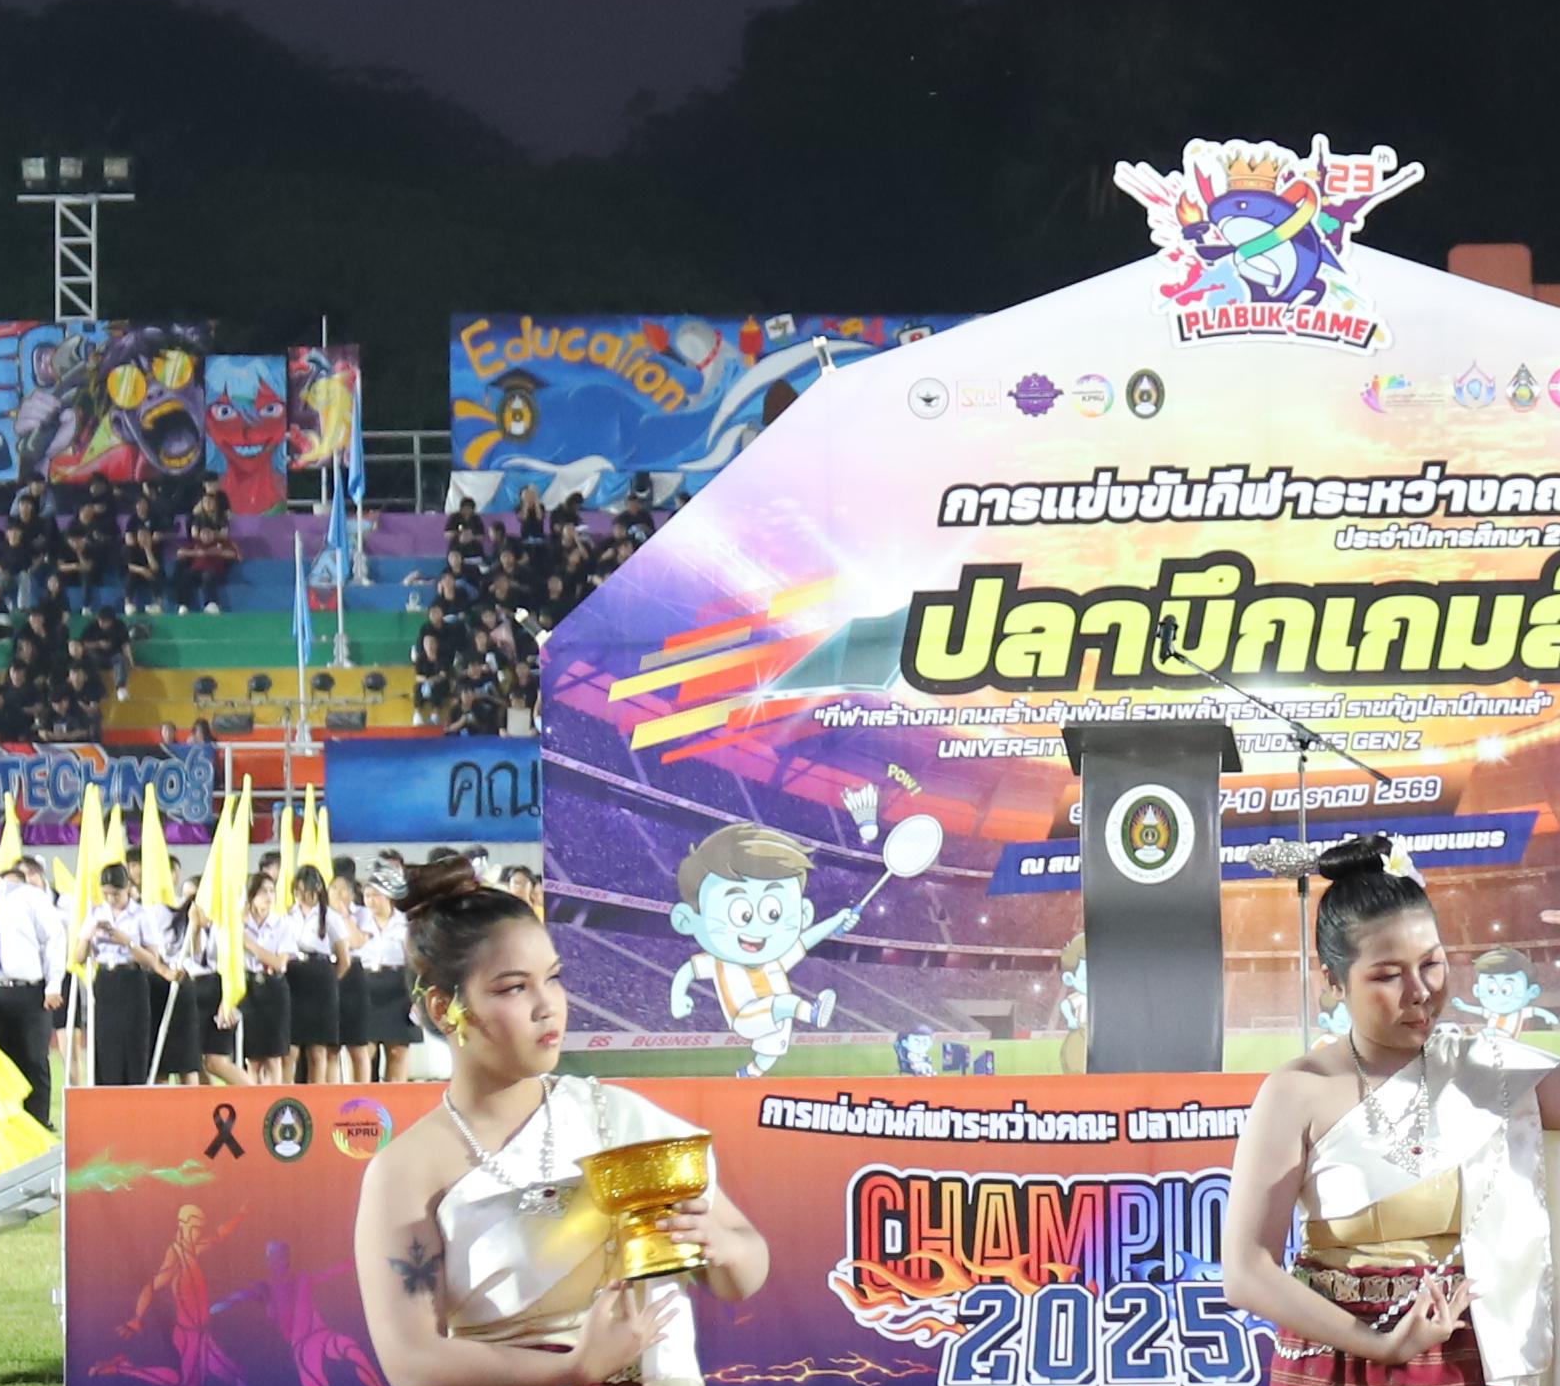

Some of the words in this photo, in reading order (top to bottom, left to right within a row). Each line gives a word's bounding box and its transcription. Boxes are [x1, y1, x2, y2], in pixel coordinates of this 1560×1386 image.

[460, 316, 690, 412] Education
[1351, 732, 1400, 751] GEN
[1400, 730, 1422, 750] Z
[1377, 774, 1443, 804] 2569
[347, 1127, 379, 1138] KPRU
[761, 1093, 1118, 1143] การแข่งขันกีฬาระหว่างคณะ
[950, 1283, 1252, 1385] 2025
